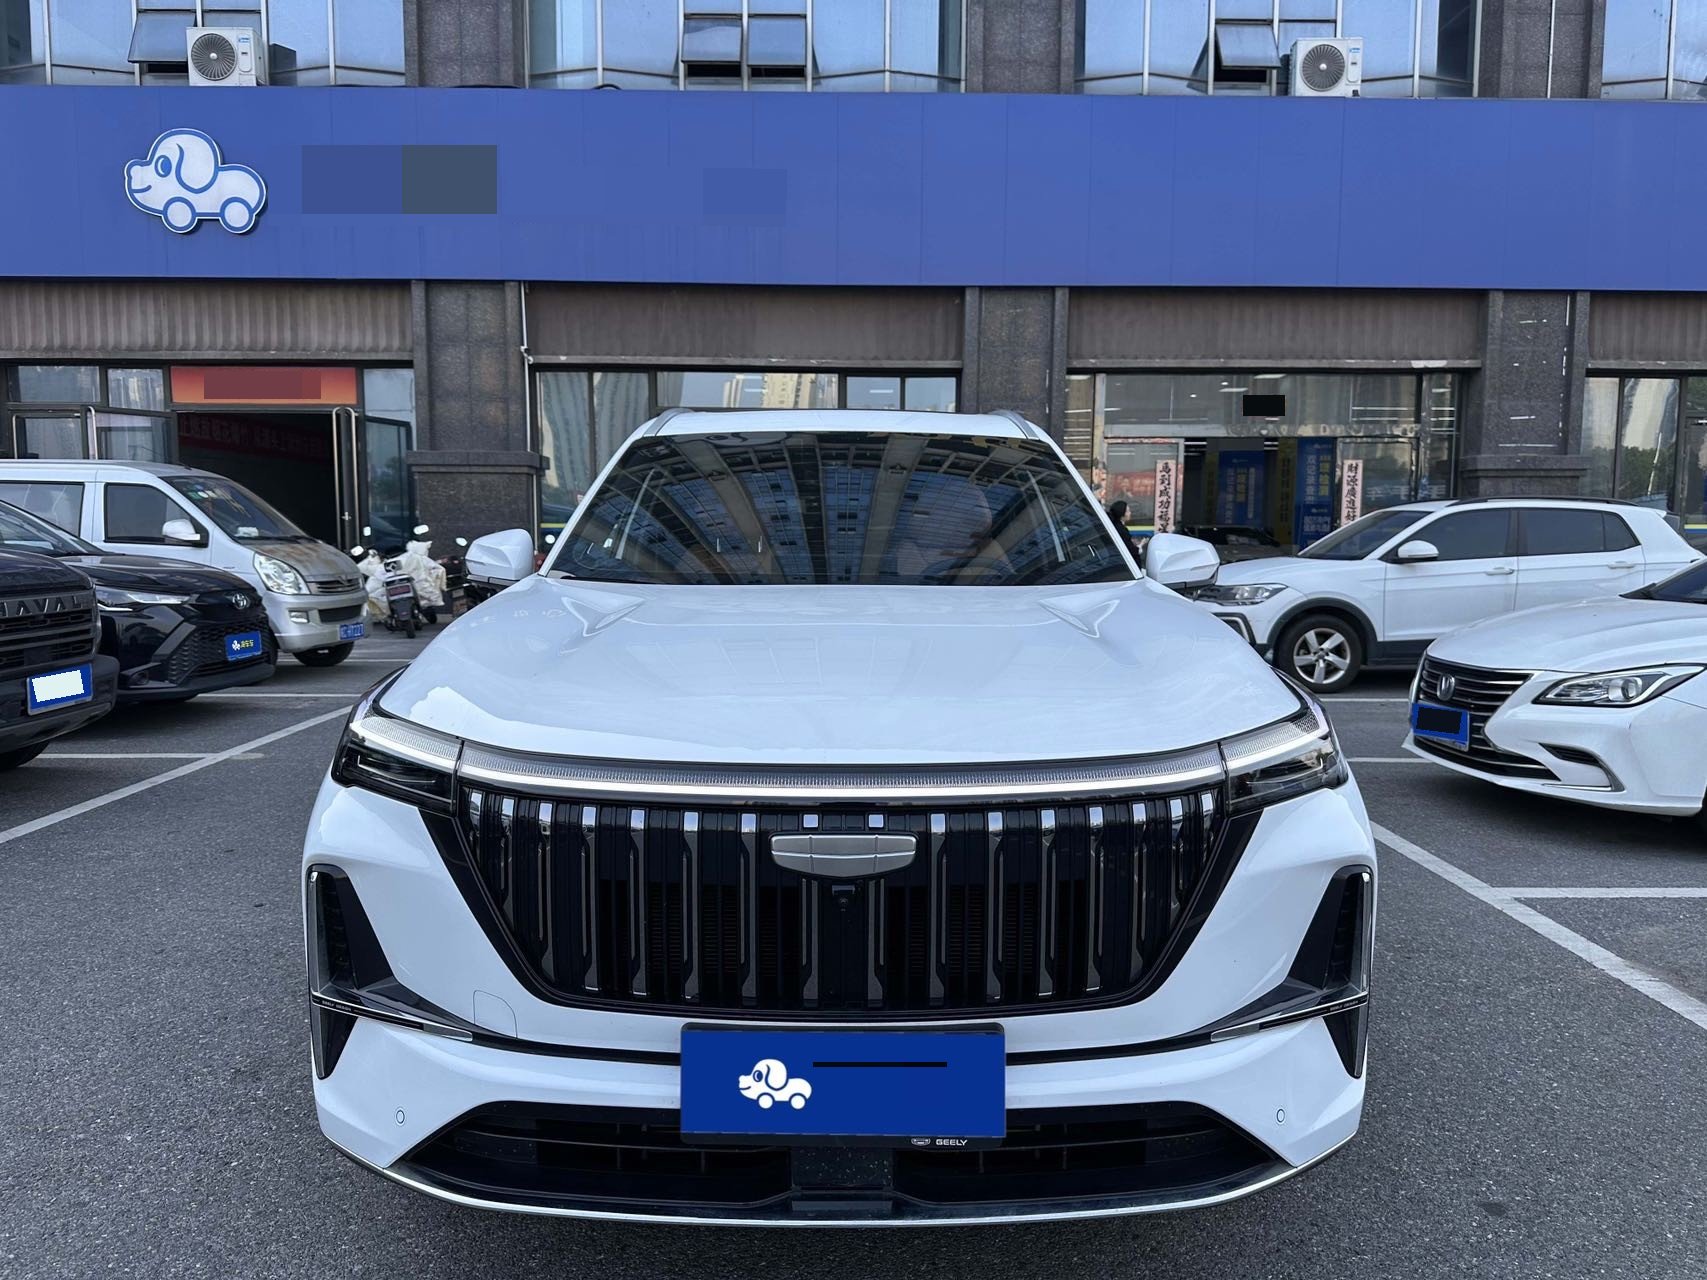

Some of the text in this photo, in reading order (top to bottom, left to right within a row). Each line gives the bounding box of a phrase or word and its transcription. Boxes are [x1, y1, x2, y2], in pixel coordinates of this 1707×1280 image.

[1344, 462, 1359, 524] 財源廣進好
[935, 1138, 968, 1147] GEELY
